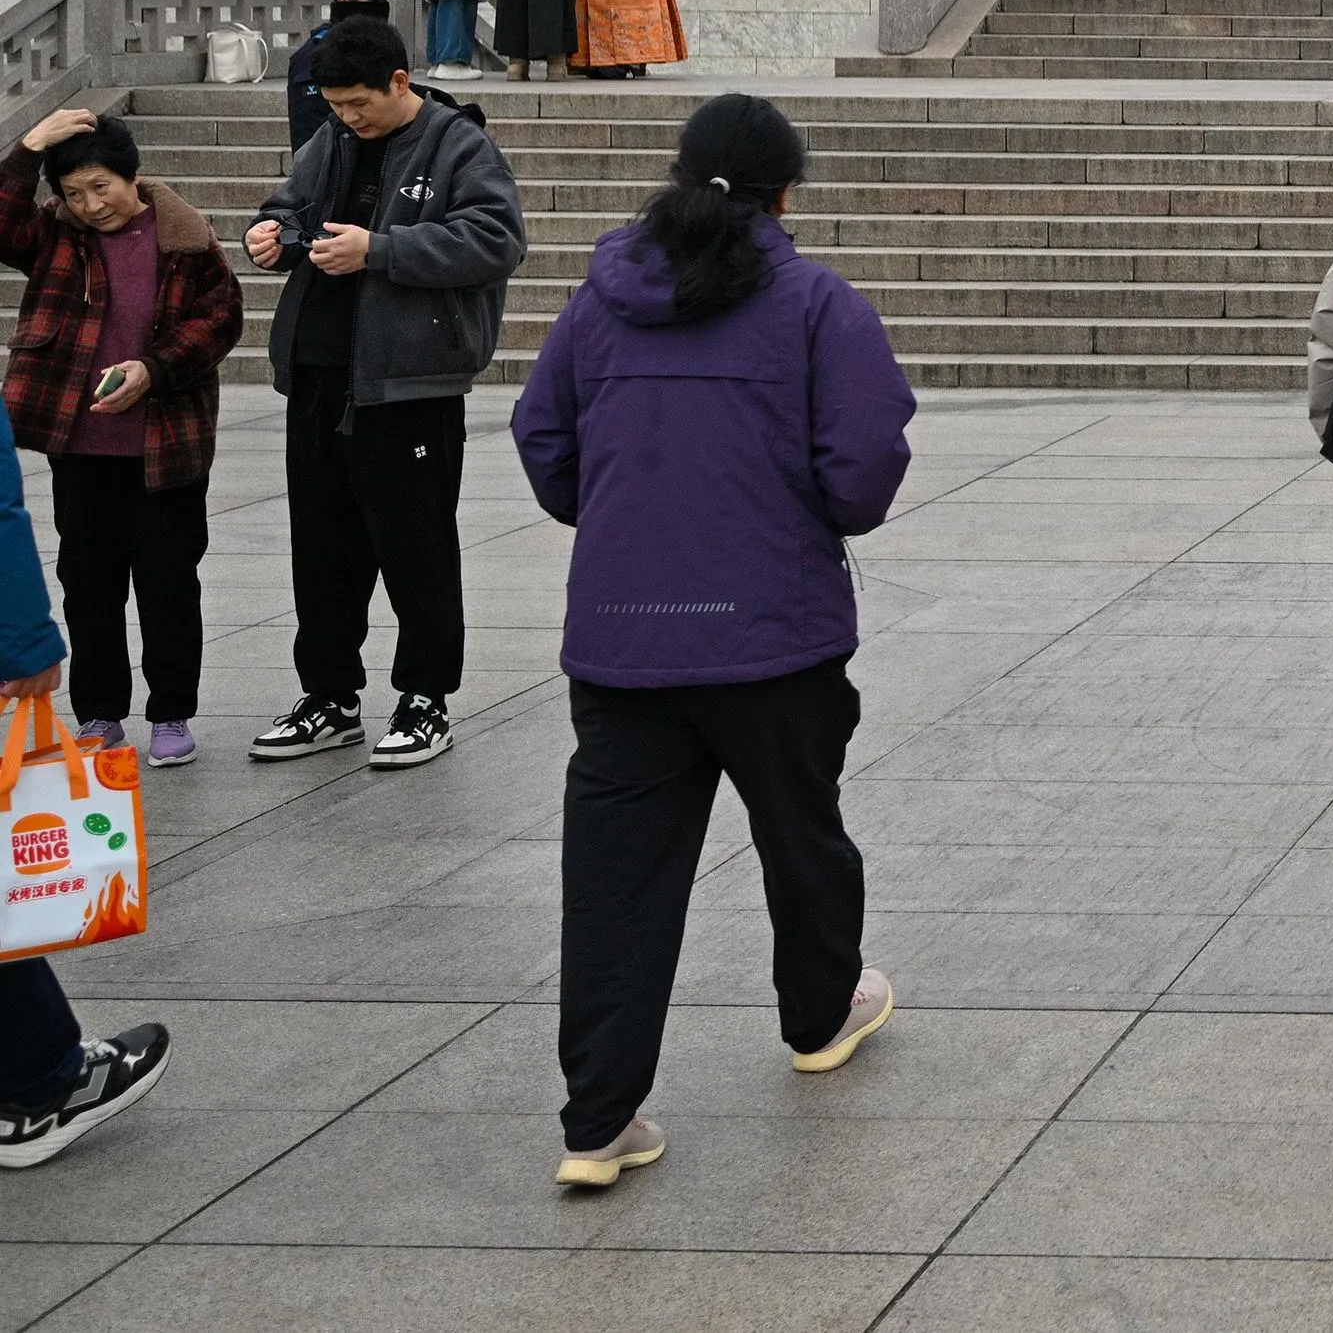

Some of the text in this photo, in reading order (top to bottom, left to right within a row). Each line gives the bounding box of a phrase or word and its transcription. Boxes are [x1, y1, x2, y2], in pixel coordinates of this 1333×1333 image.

[12, 828, 68, 848] BURGER
[13, 841, 70, 866] KING
[7, 877, 85, 903] 火烤汉堡专家
